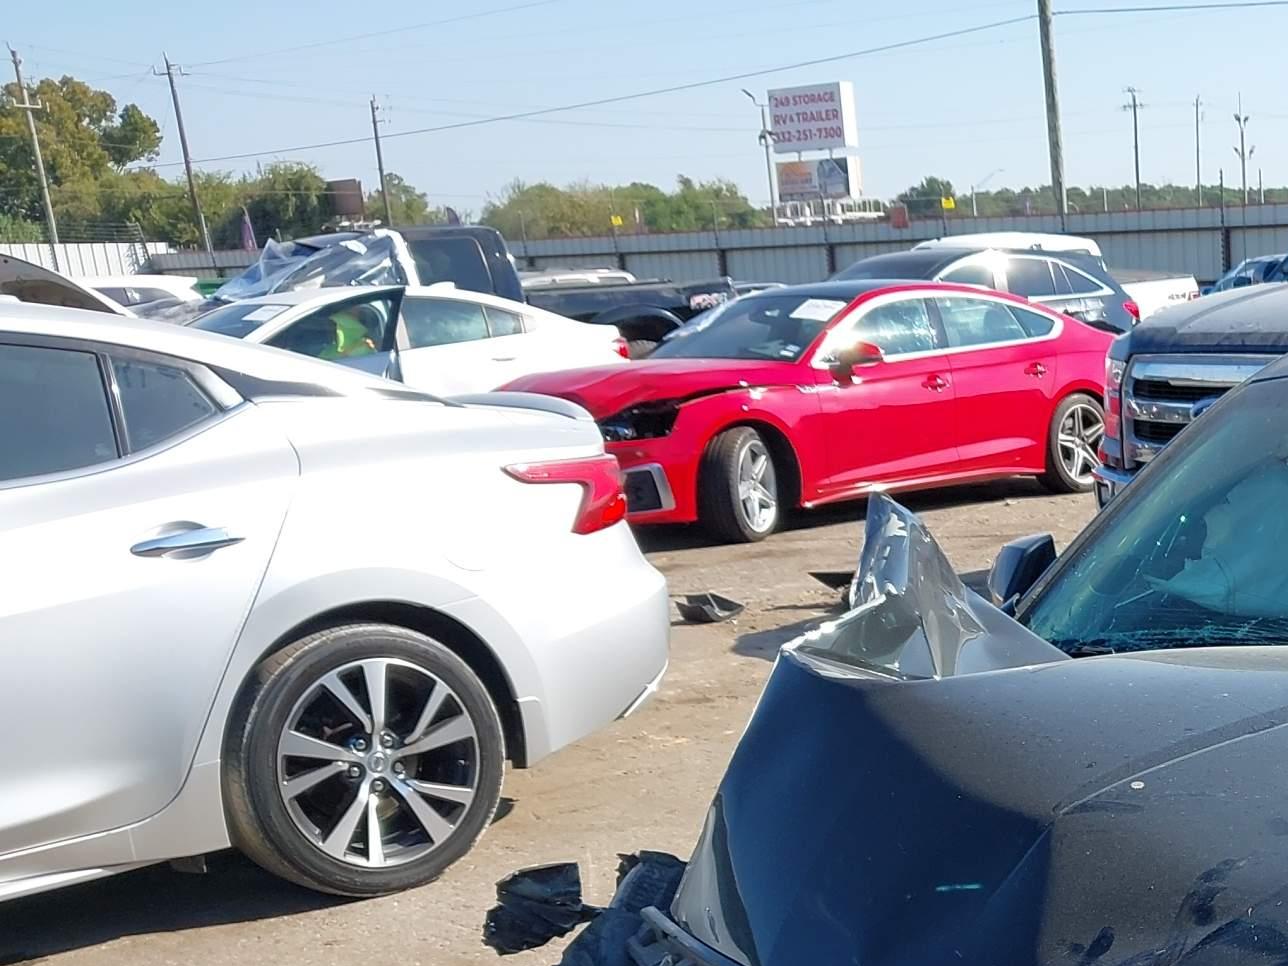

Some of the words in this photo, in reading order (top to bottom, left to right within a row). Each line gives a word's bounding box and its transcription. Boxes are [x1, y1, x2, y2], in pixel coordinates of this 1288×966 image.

[773, 95, 790, 108] 249
[792, 91, 834, 105] STORAGE
[773, 113, 787, 125] RV
[796, 108, 839, 123] TRAILER
